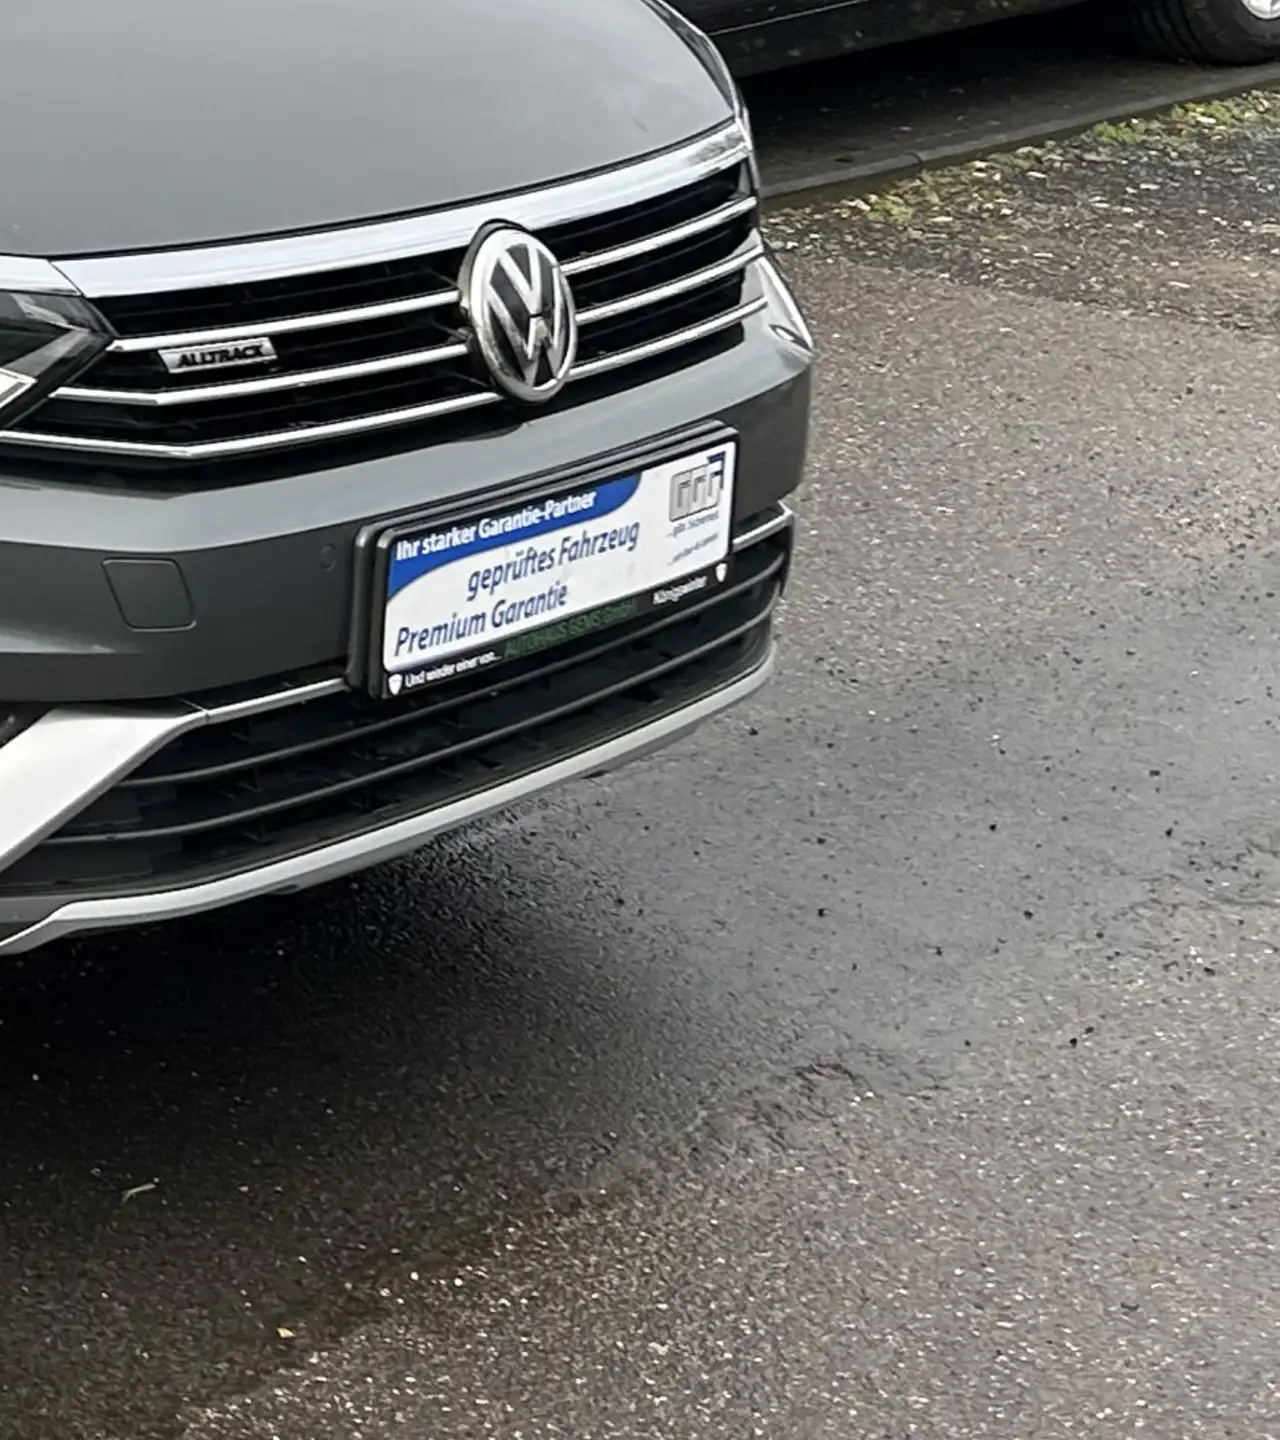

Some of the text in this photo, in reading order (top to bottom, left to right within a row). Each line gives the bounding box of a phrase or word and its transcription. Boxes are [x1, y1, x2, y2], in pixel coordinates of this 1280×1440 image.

[177, 344, 264, 368] ALLTRACK
[396, 491, 597, 561] Ihr starker Garantie-Partner
[467, 547, 555, 602] geprüftes
[558, 521, 640, 566] Fahrzeug
[394, 580, 568, 657] Premium Garantie
